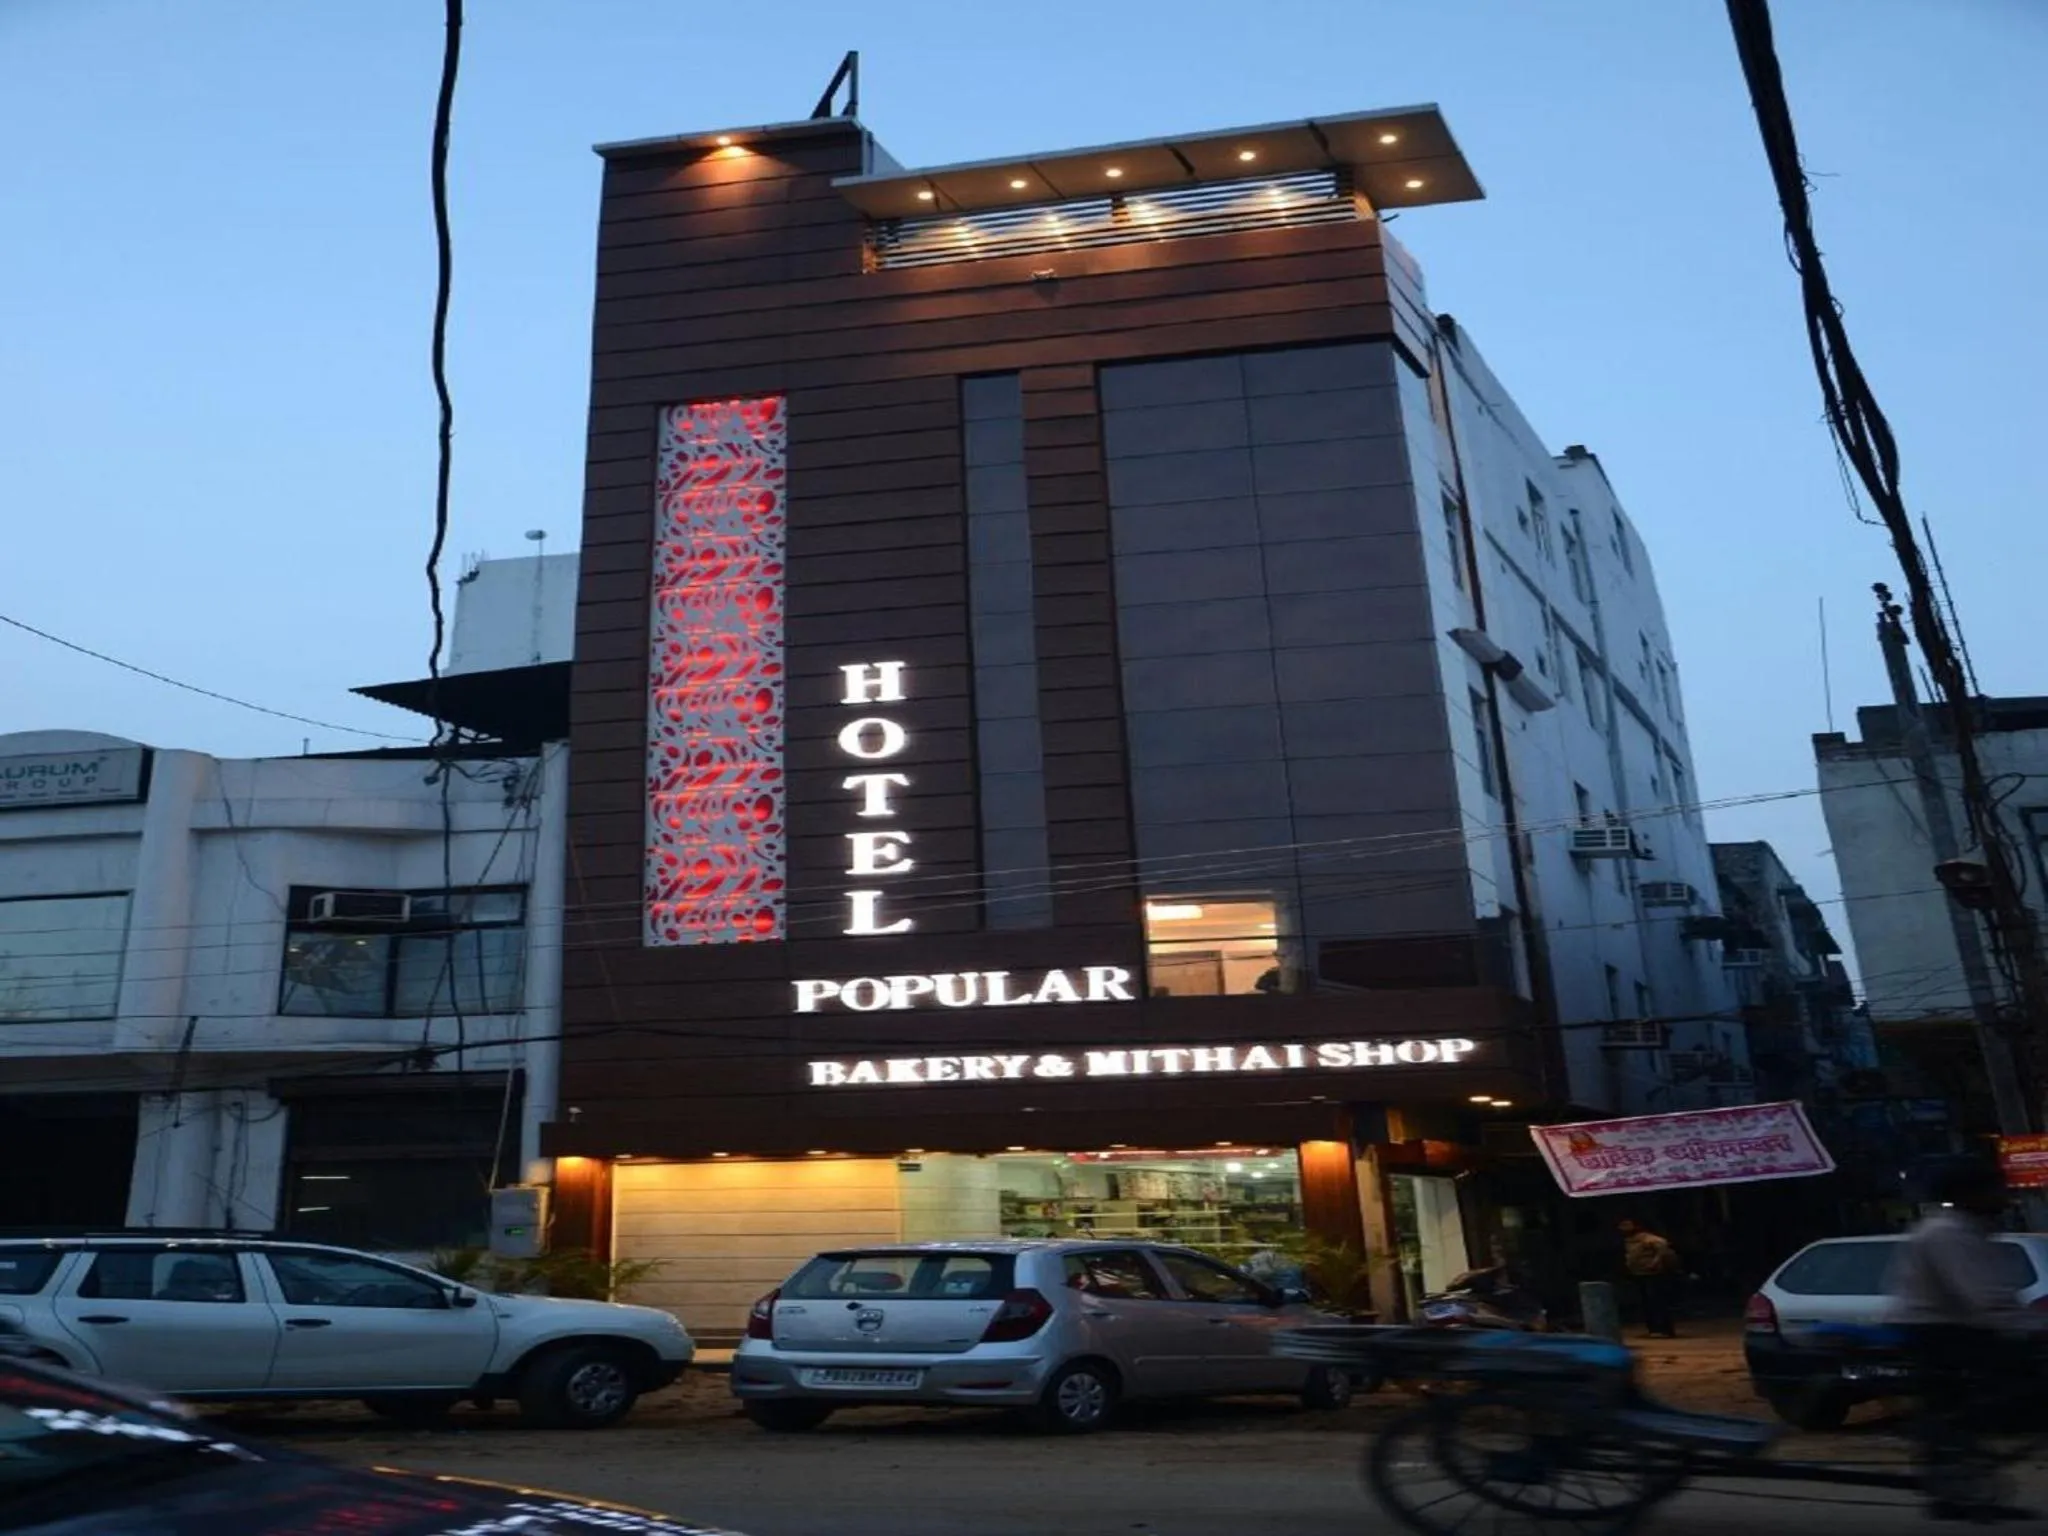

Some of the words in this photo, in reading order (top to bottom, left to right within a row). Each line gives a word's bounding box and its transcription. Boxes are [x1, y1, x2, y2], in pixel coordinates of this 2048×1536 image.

[837, 660, 914, 936] HOTEL
[792, 966, 1134, 1012] POPULAR
[808, 1054, 1030, 1085] BAKERY
[1032, 1053, 1074, 1077] &
[1084, 1044, 1304, 1076] MITHAI
[1316, 1037, 1476, 1067] SHOP
